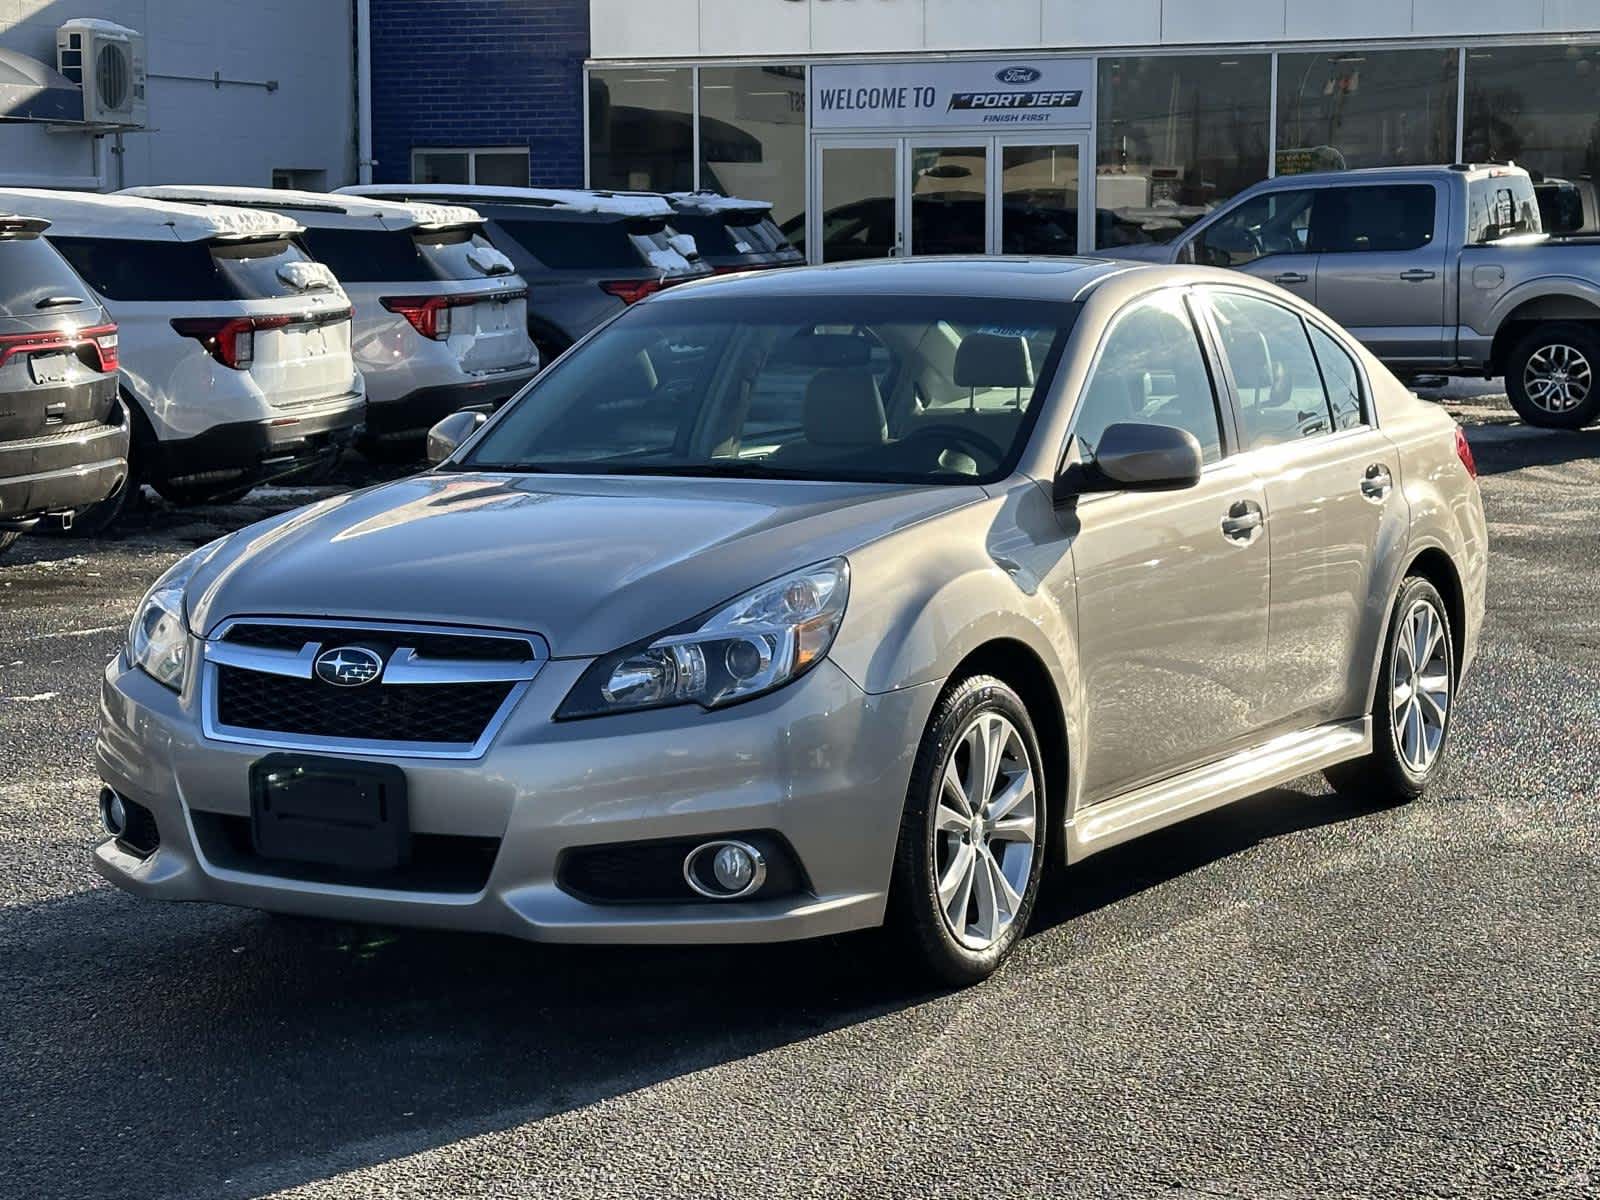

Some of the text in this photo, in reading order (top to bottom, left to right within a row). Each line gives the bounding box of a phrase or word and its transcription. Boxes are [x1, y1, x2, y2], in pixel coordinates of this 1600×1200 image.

[1004, 68, 1033, 82] Ford
[820, 87, 936, 110] WELCOME TO
[970, 94, 1025, 108] PORT
[1026, 92, 1076, 107] JEFF
[982, 113, 1051, 122] FINISH FIRST
